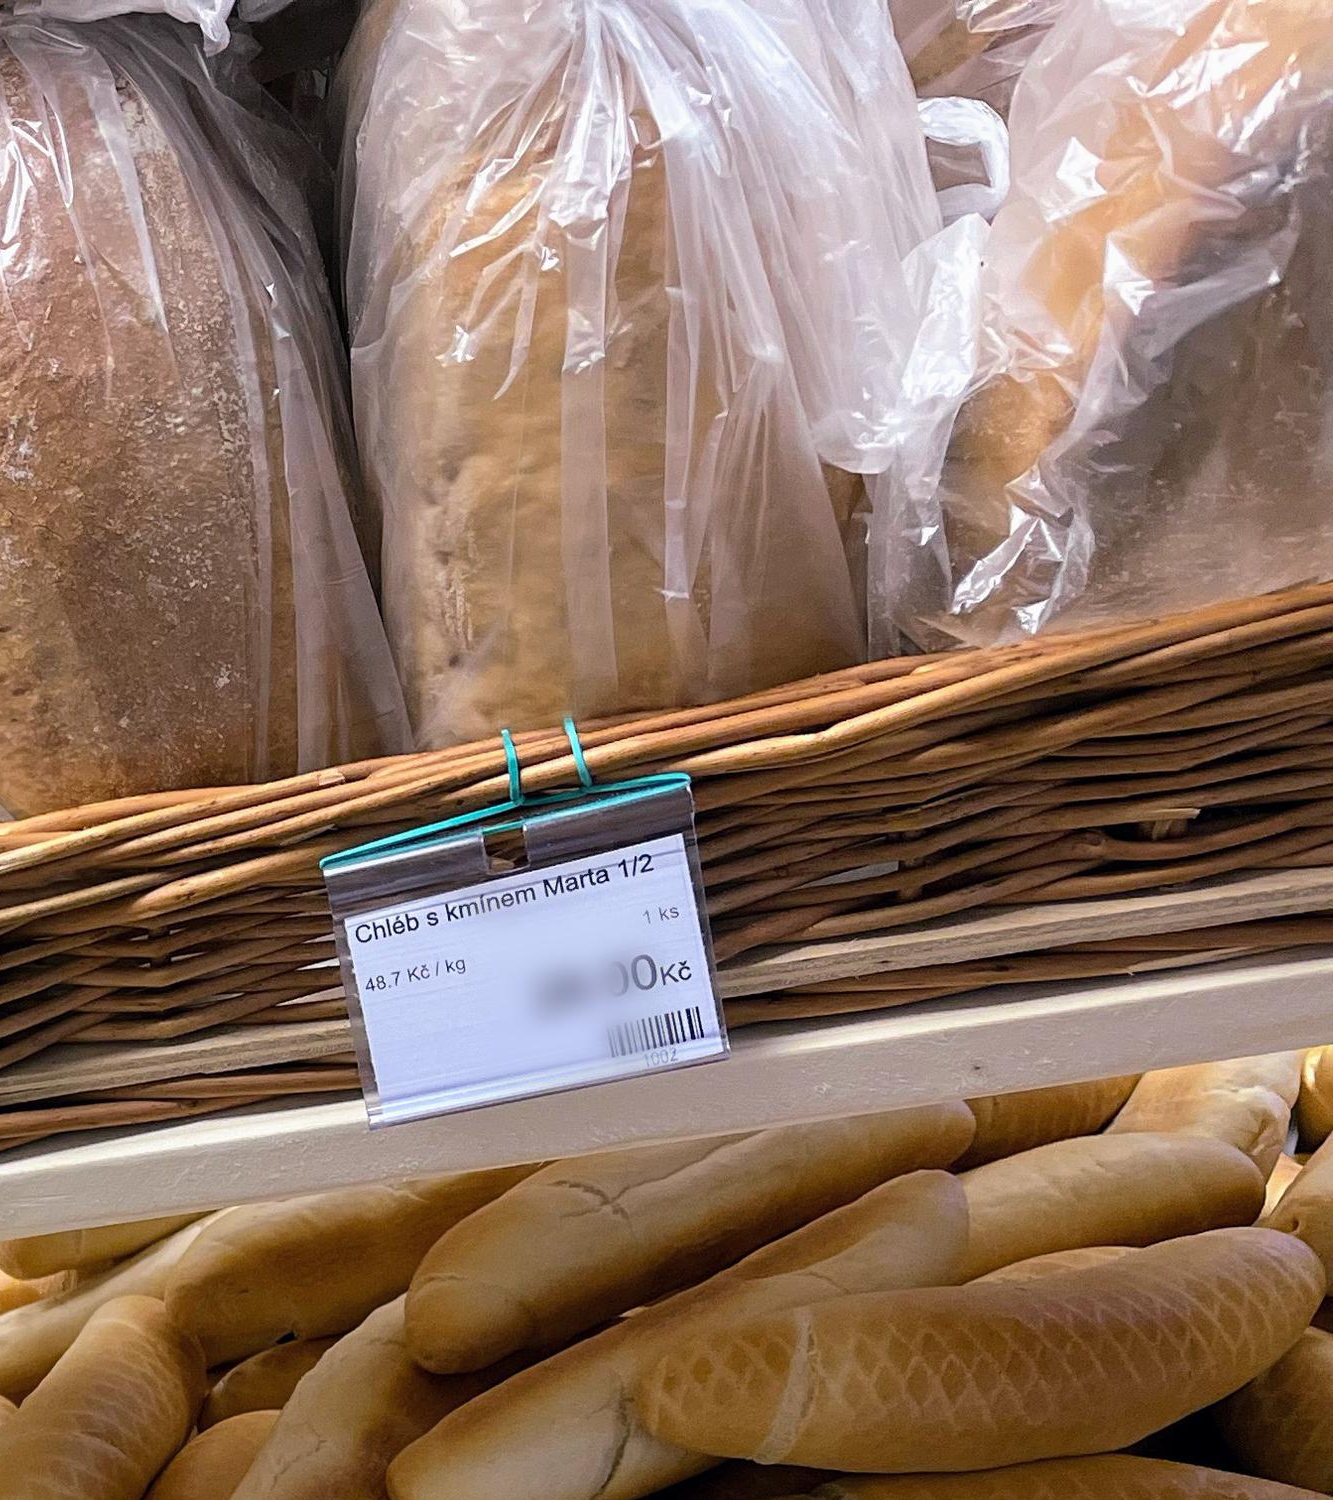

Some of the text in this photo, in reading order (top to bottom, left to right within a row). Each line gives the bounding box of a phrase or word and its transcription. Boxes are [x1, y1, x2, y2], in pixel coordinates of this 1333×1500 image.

[355, 853, 655, 943] Chléb s kmínem Marta 1/2
[642, 906, 680, 925] 1 ks
[365, 972, 401, 992] 48.7
[407, 963, 431, 982] Kč
[445, 959, 466, 974] kg
